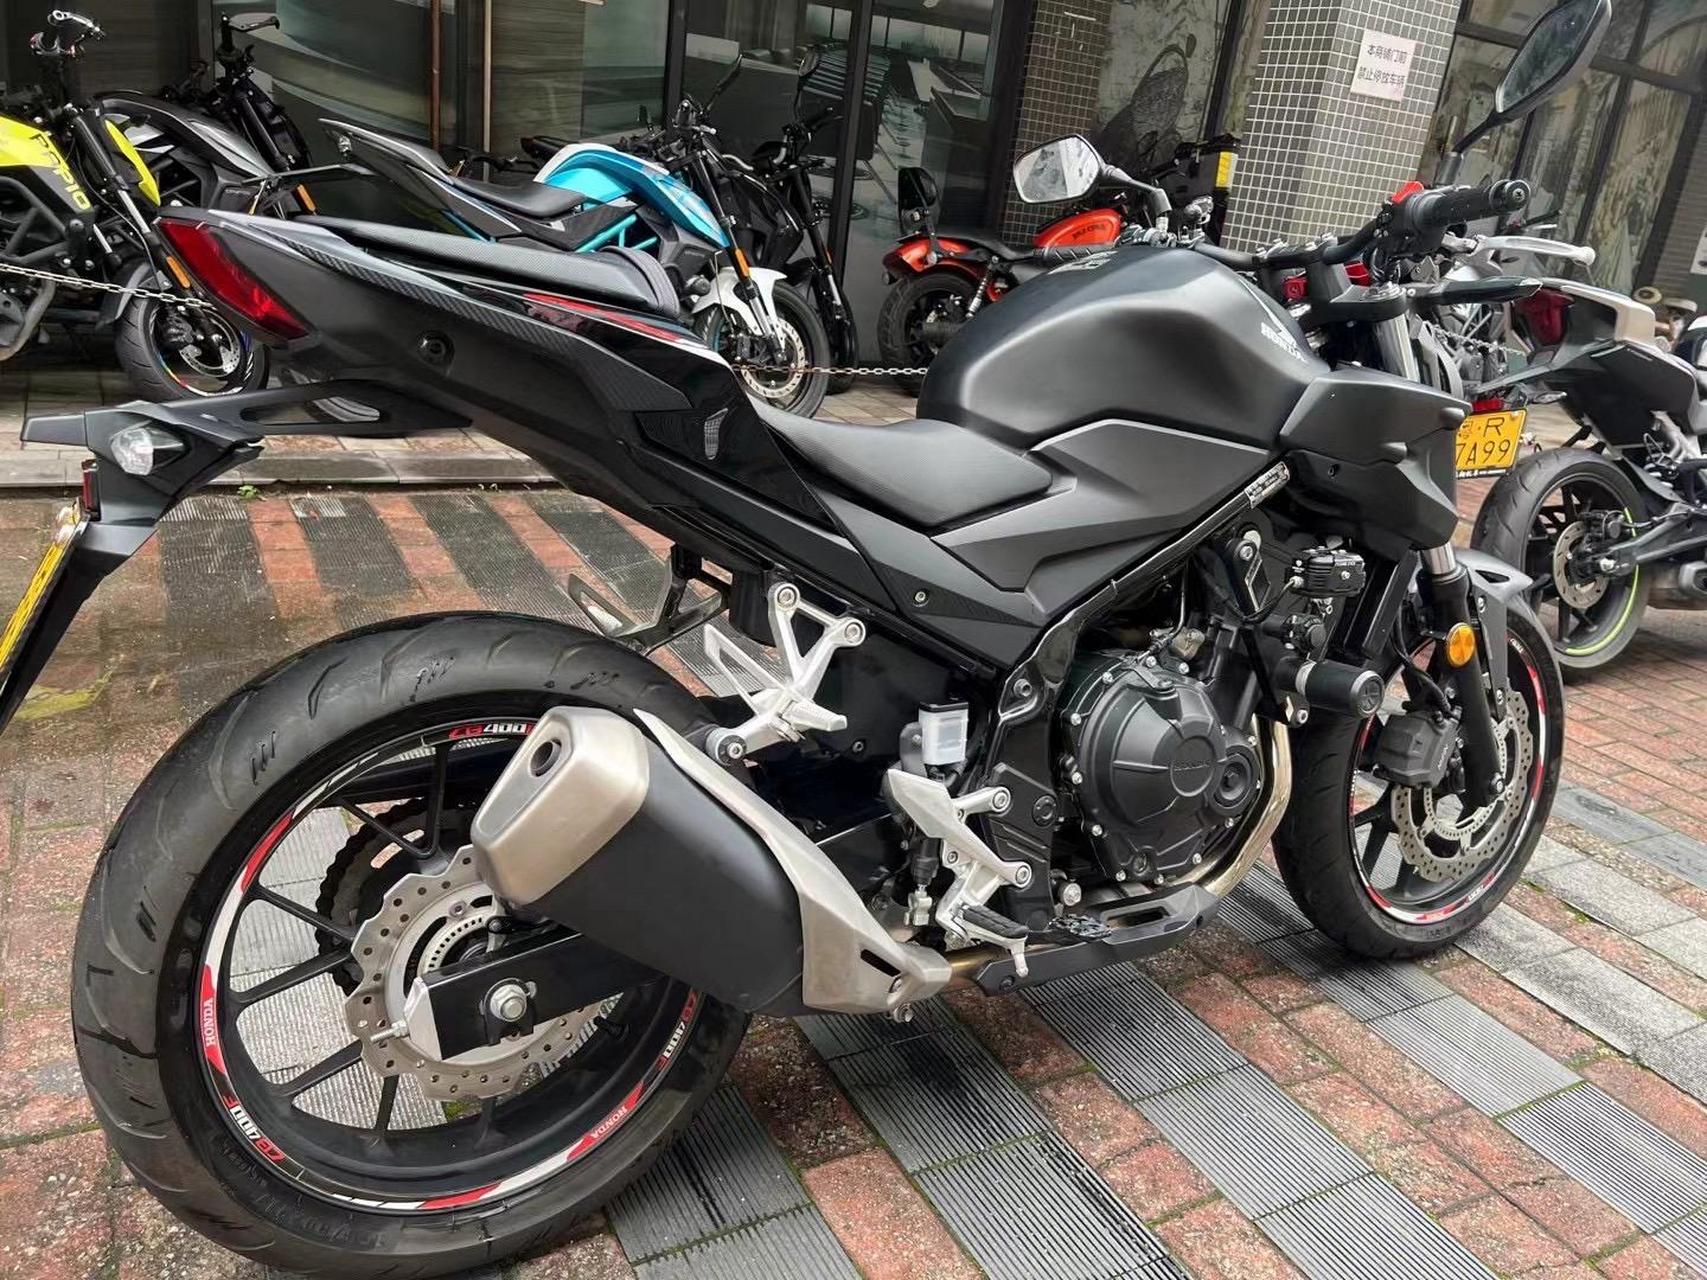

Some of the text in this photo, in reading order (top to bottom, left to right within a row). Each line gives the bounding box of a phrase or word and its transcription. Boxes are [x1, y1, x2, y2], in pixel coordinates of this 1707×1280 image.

[203, 998, 216, 1047] HONDA
[213, 1095, 285, 1161] CB400F
[590, 1105, 628, 1139] HONDA
